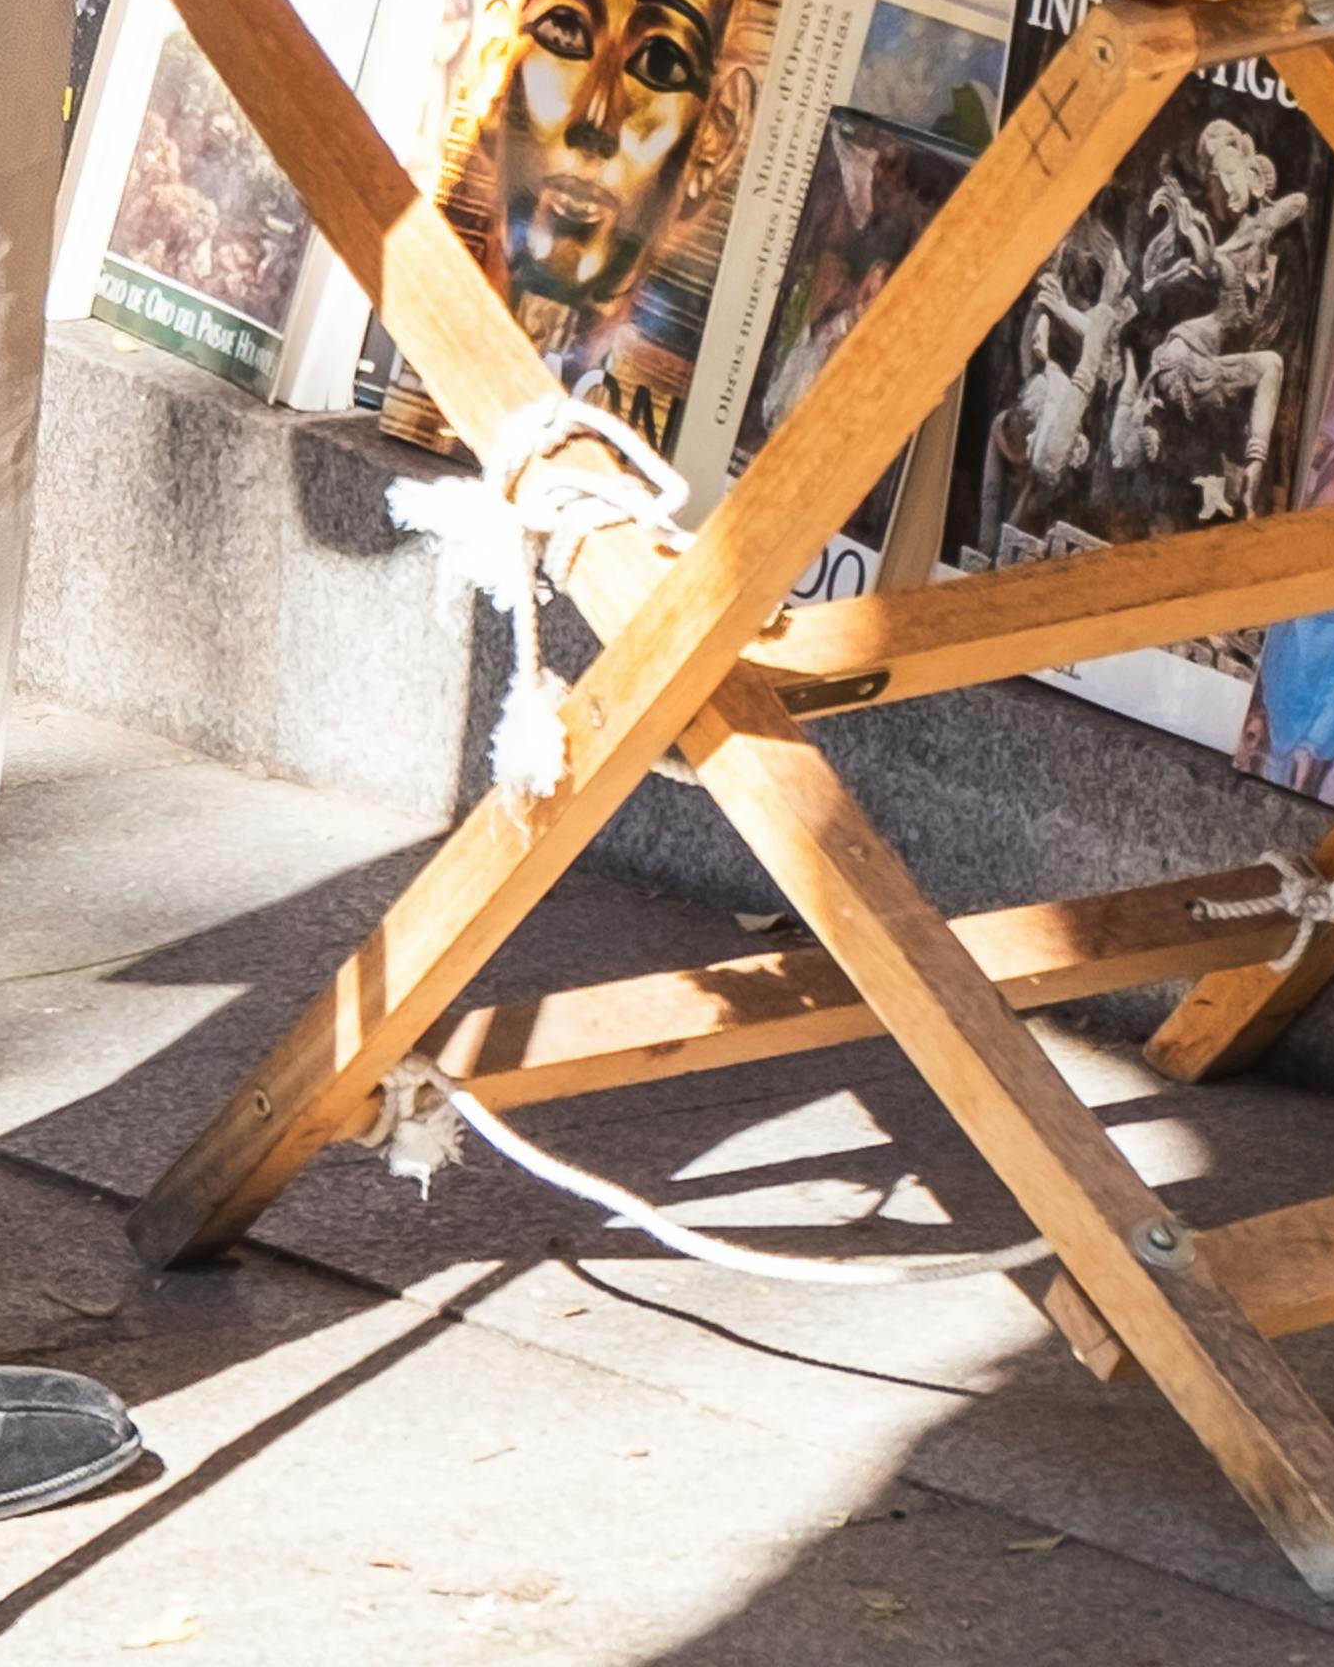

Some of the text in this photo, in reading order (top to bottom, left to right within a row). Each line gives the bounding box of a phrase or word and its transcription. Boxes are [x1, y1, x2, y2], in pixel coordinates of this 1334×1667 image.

[713, 2, 836, 427] Obras maestras impresionistas
[753, 108, 784, 200] Musée
